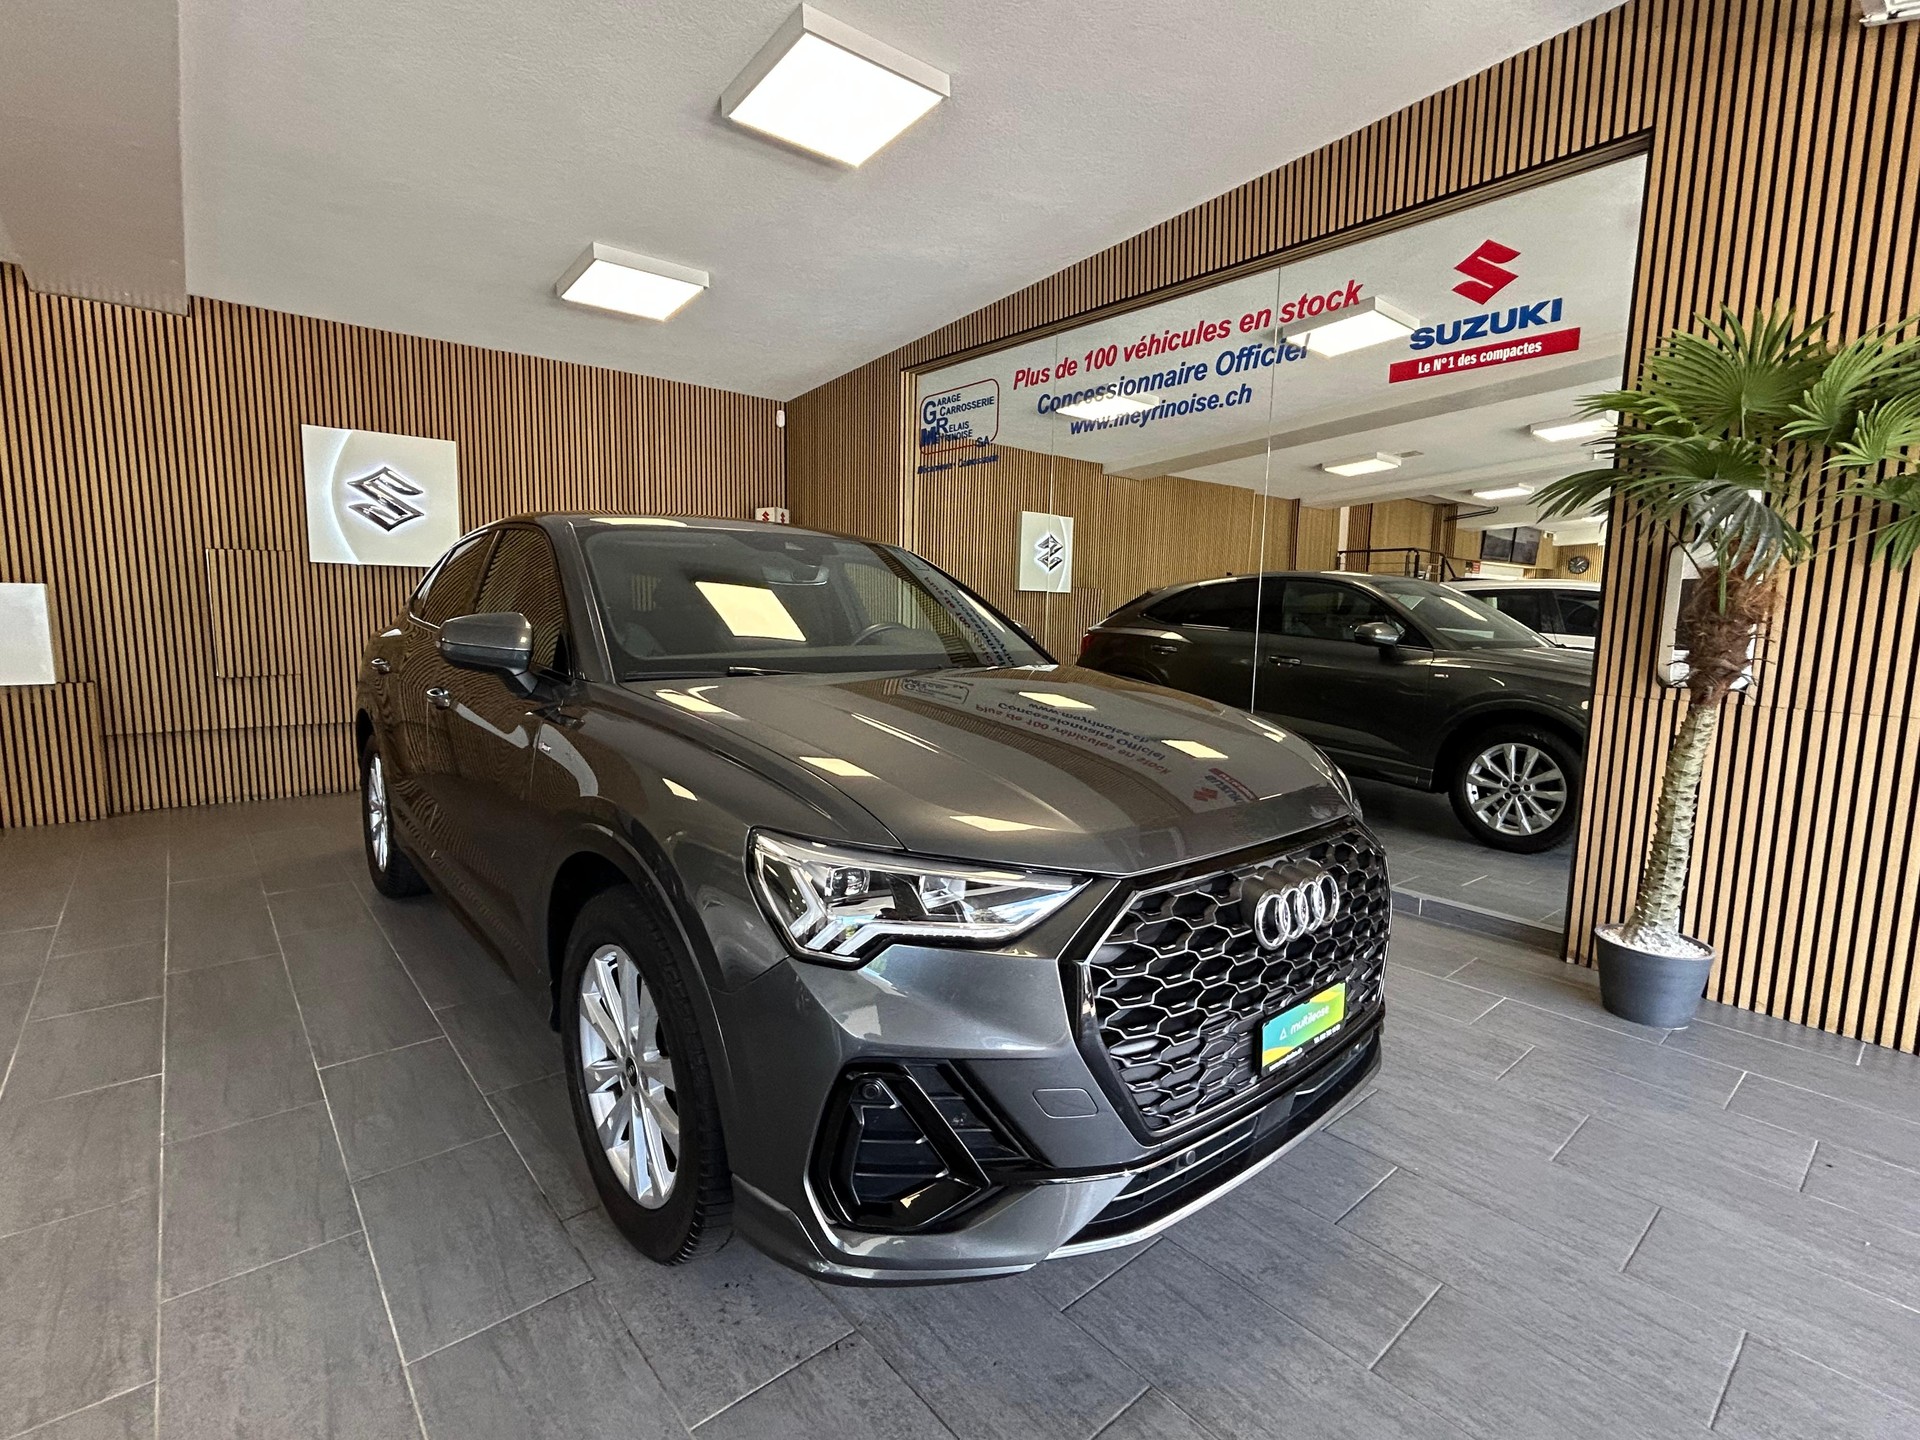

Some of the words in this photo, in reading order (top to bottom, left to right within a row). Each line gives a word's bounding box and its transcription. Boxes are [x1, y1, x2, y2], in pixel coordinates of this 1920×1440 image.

[1013, 367, 1050, 390] Plus
[1055, 357, 1078, 379] de
[1084, 344, 1118, 373] 100
[1124, 319, 1232, 362] véhicules
[1239, 308, 1271, 333] en
[1279, 279, 1364, 323] stock
[1409, 297, 1563, 351] SUZUKI
[1037, 361, 1208, 415] Concessionnaire
[1216, 332, 1311, 376] Officiel
[1418, 361, 1430, 374] Le
[1457, 353, 1477, 367] des
[1479, 341, 1543, 363] compactes
[923, 393, 961, 425] GARAGE
[940, 396, 995, 416] CARROSSERIE
[1070, 384, 1252, 435] www.meyrinoise.ch
